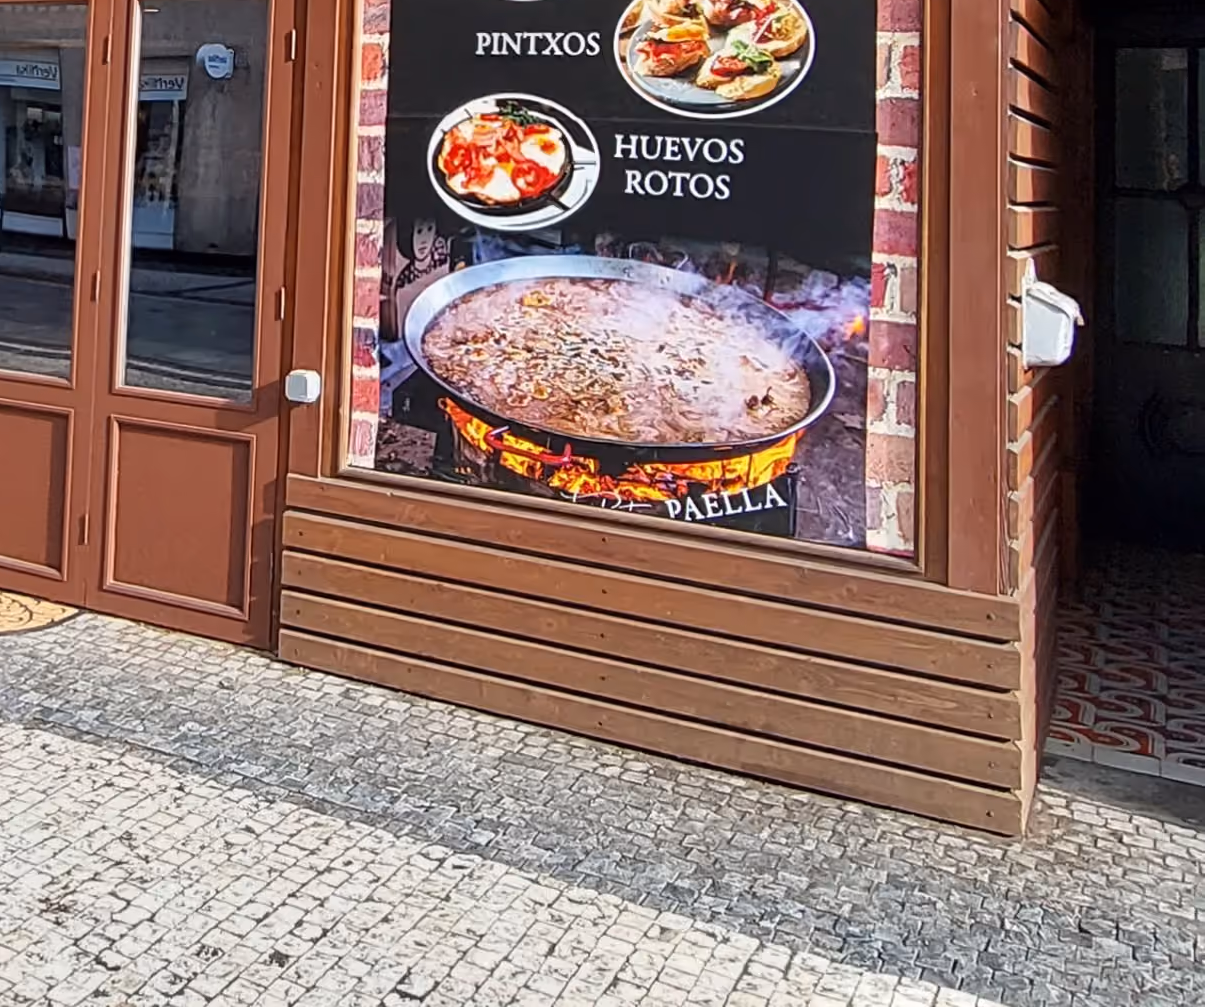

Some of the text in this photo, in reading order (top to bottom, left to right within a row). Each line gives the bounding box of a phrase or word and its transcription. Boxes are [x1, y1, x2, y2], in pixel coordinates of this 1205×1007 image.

[475, 31, 602, 56] PINTXOS
[614, 134, 745, 164] HUEVOS
[624, 170, 731, 200] ROTOS
[664, 483, 789, 522] PAELLA
